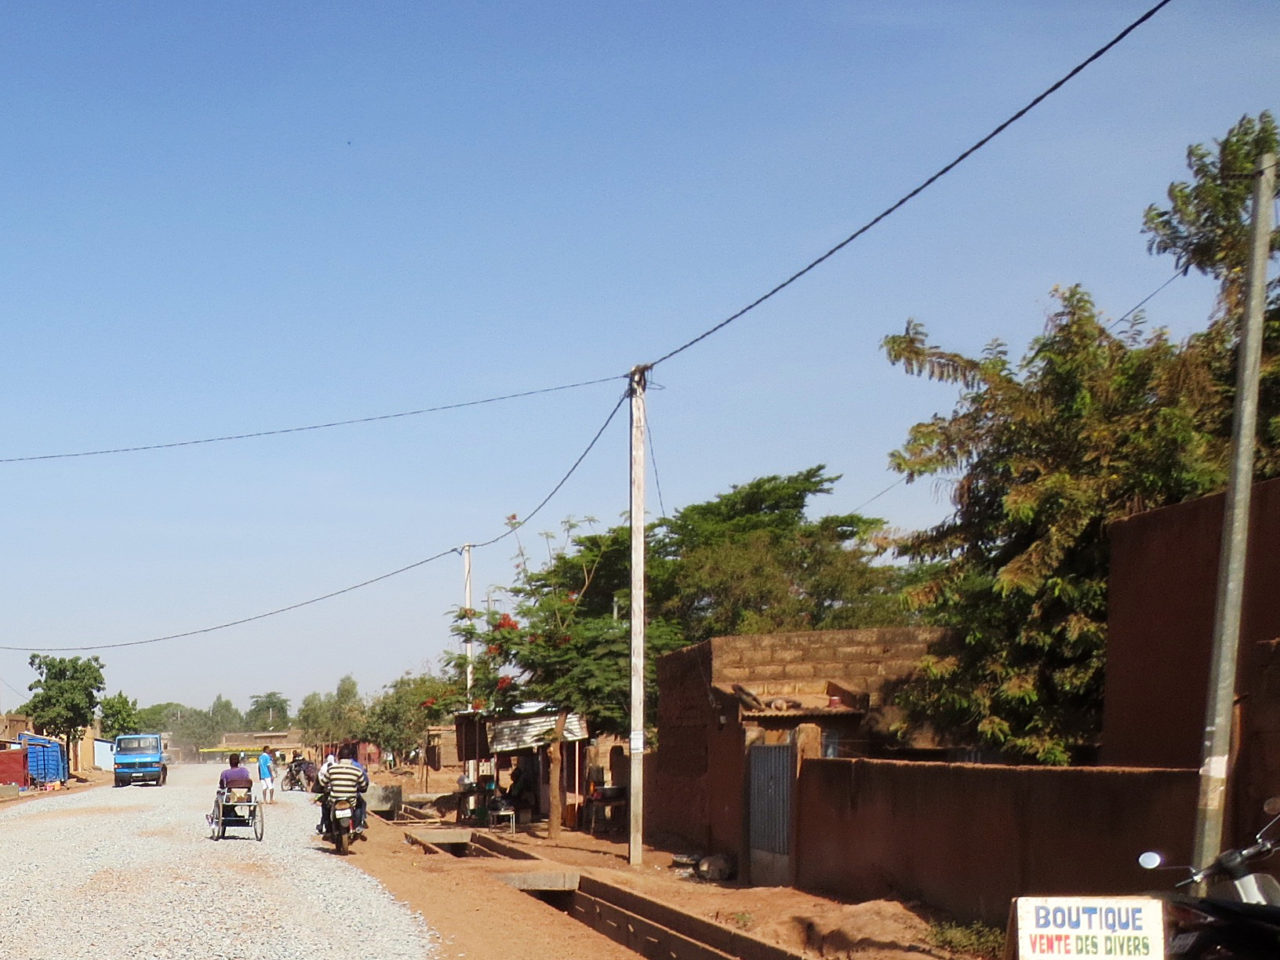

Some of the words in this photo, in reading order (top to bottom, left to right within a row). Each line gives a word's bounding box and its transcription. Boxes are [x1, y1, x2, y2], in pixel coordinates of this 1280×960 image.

[1035, 906, 1143, 932] BOUTIQUE
[1030, 934, 1071, 955] VENTE
[1076, 935, 1098, 955] DES
[1104, 936, 1150, 956] DIVERS
